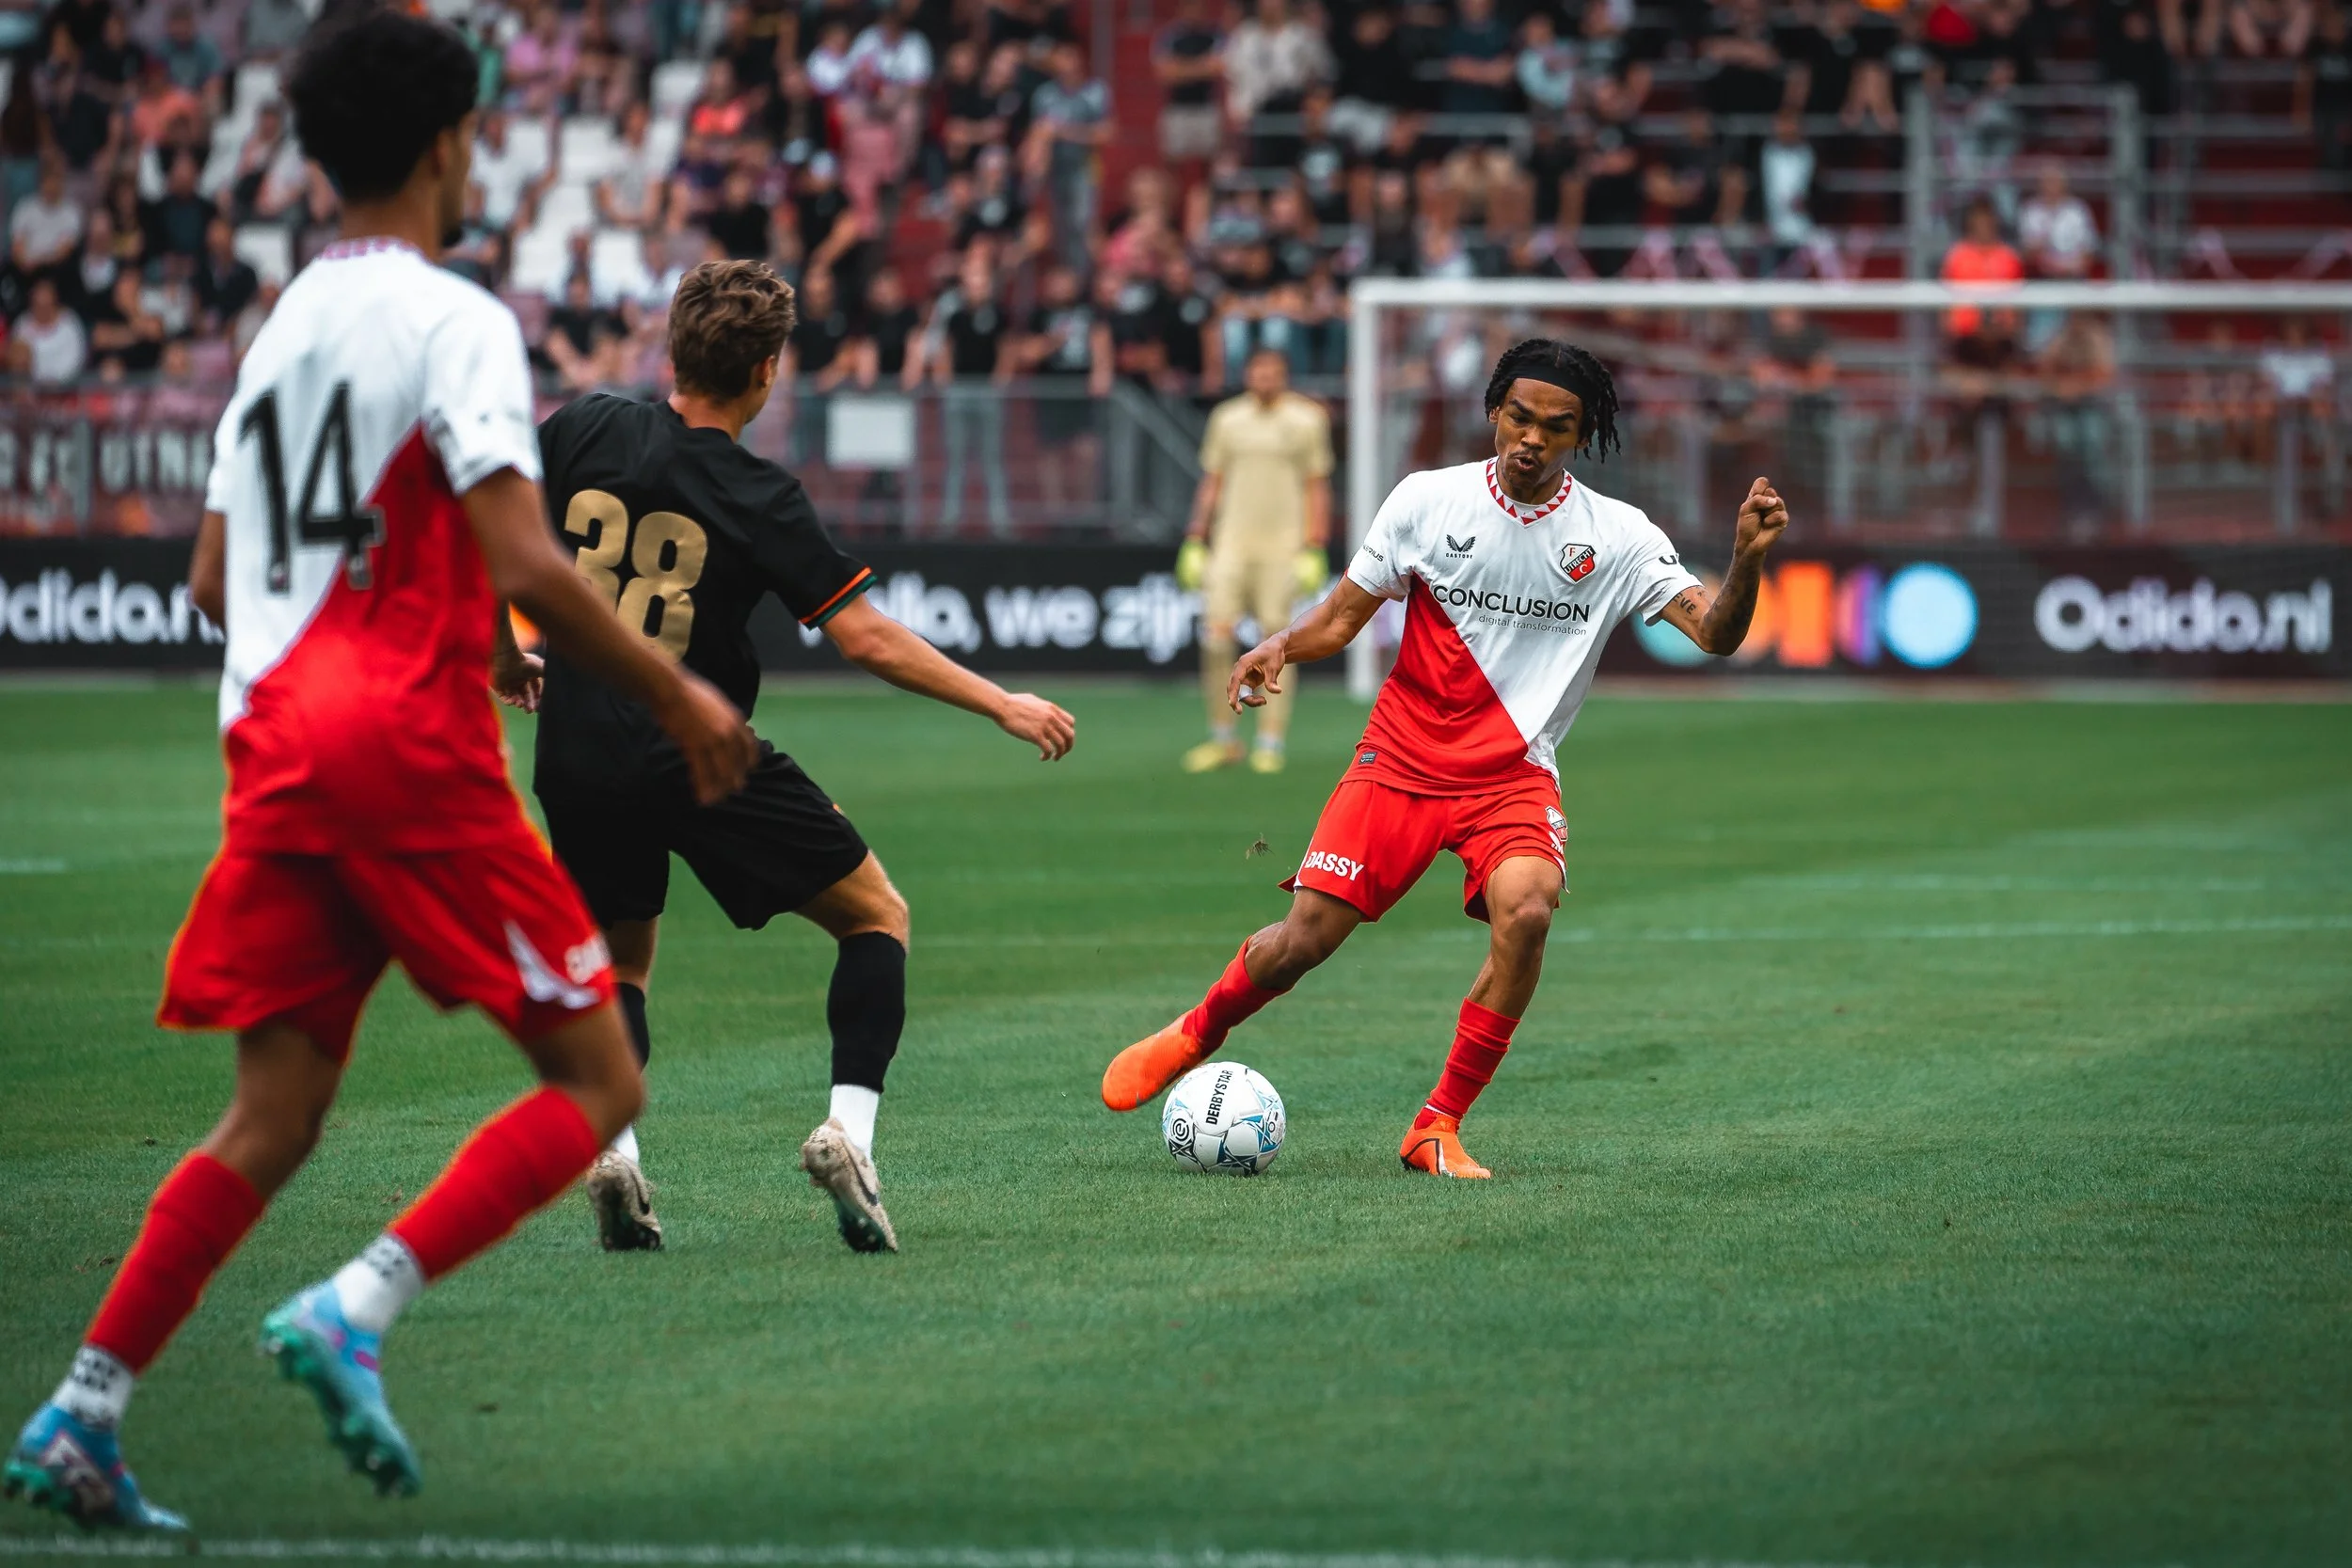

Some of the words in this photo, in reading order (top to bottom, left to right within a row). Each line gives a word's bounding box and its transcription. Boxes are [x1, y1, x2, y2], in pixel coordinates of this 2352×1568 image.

[238, 380, 386, 594] 14
[564, 488, 707, 664] 38
[1564, 547, 1595, 574] UTRECHT
[1580, 563, 1588, 574] C
[0, 567, 226, 644] dido.n
[984, 584, 1099, 649] we
[1433, 585, 1591, 623] CONCLUSION
[1478, 614, 1510, 628] digital
[1513, 621, 1587, 637] transformation
[2033, 574, 2333, 654] Odido.nl
[1304, 850, 1365, 881] DASSY
[1205, 1069, 1233, 1126] DERBYSTAR
